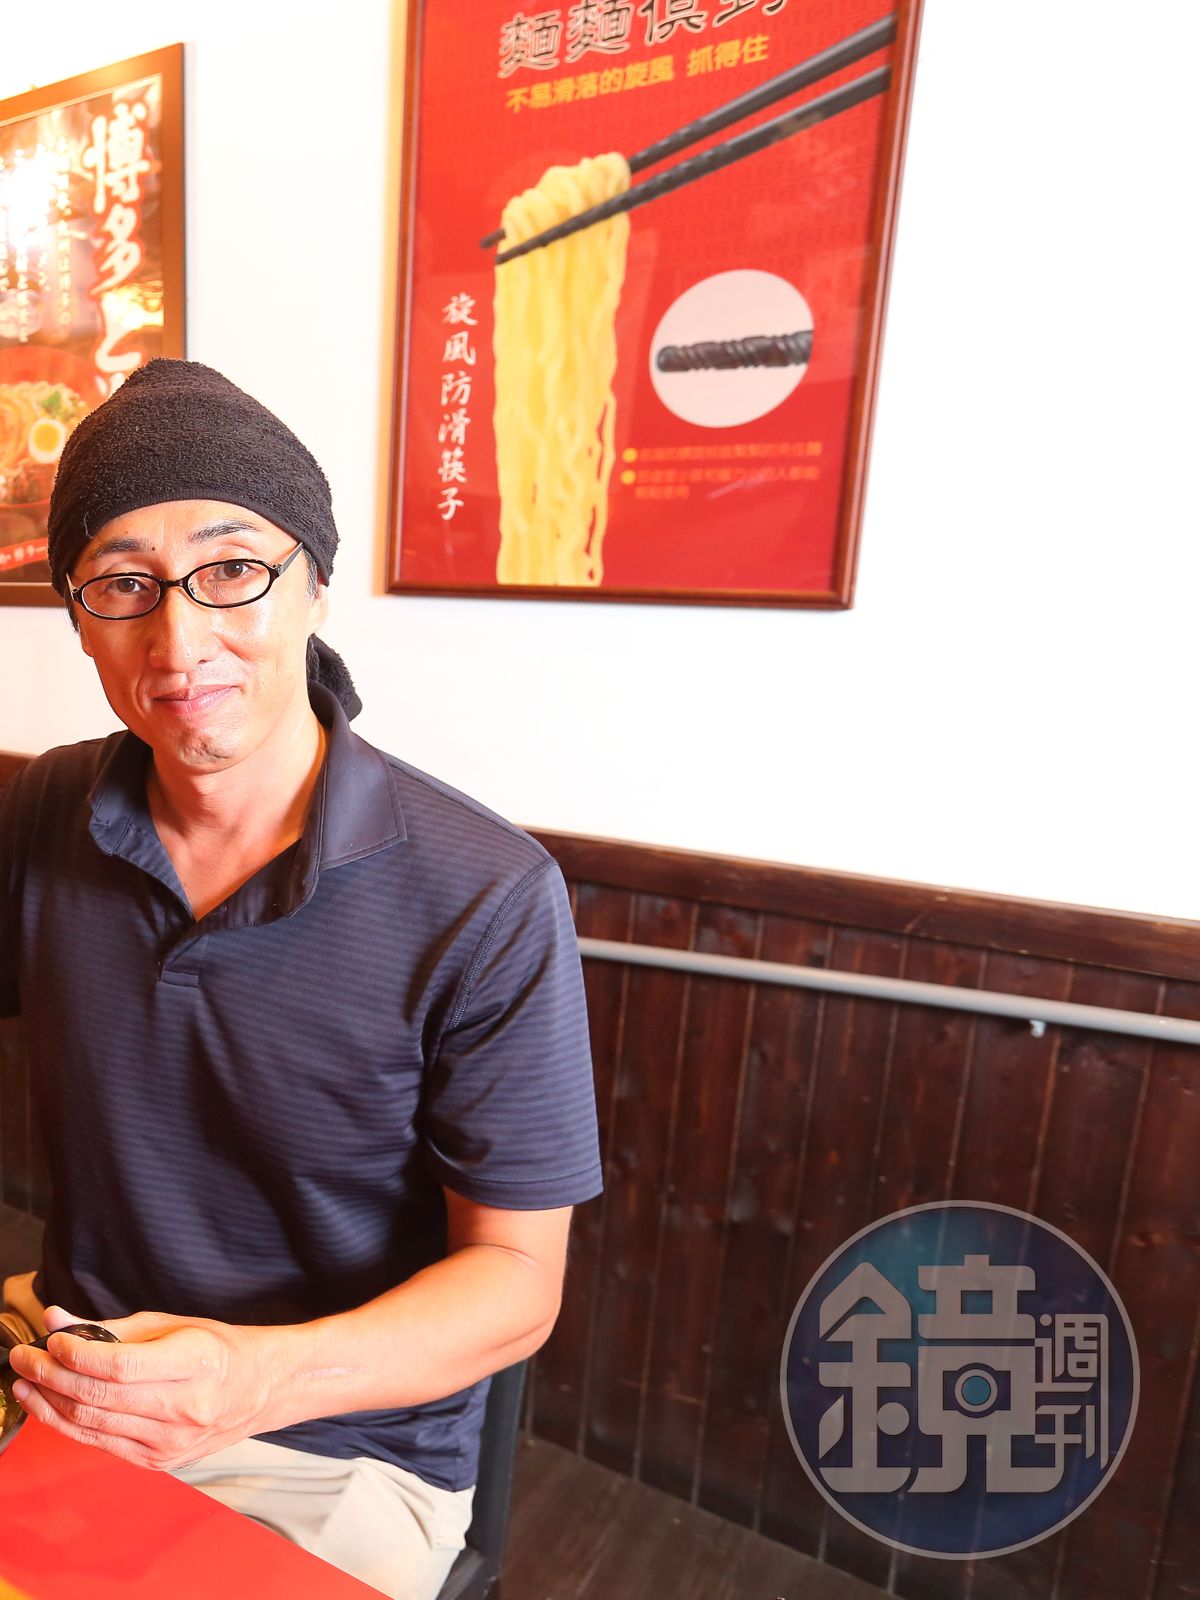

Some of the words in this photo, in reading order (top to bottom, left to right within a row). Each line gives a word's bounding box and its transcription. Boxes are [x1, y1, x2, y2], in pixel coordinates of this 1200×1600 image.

[506, 55, 675, 114] 不易滑落的旋風
[686, 34, 770, 77] 抓得住
[81, 101, 160, 402] 博多と
[437, 291, 479, 521] 旋風防滑筷子
